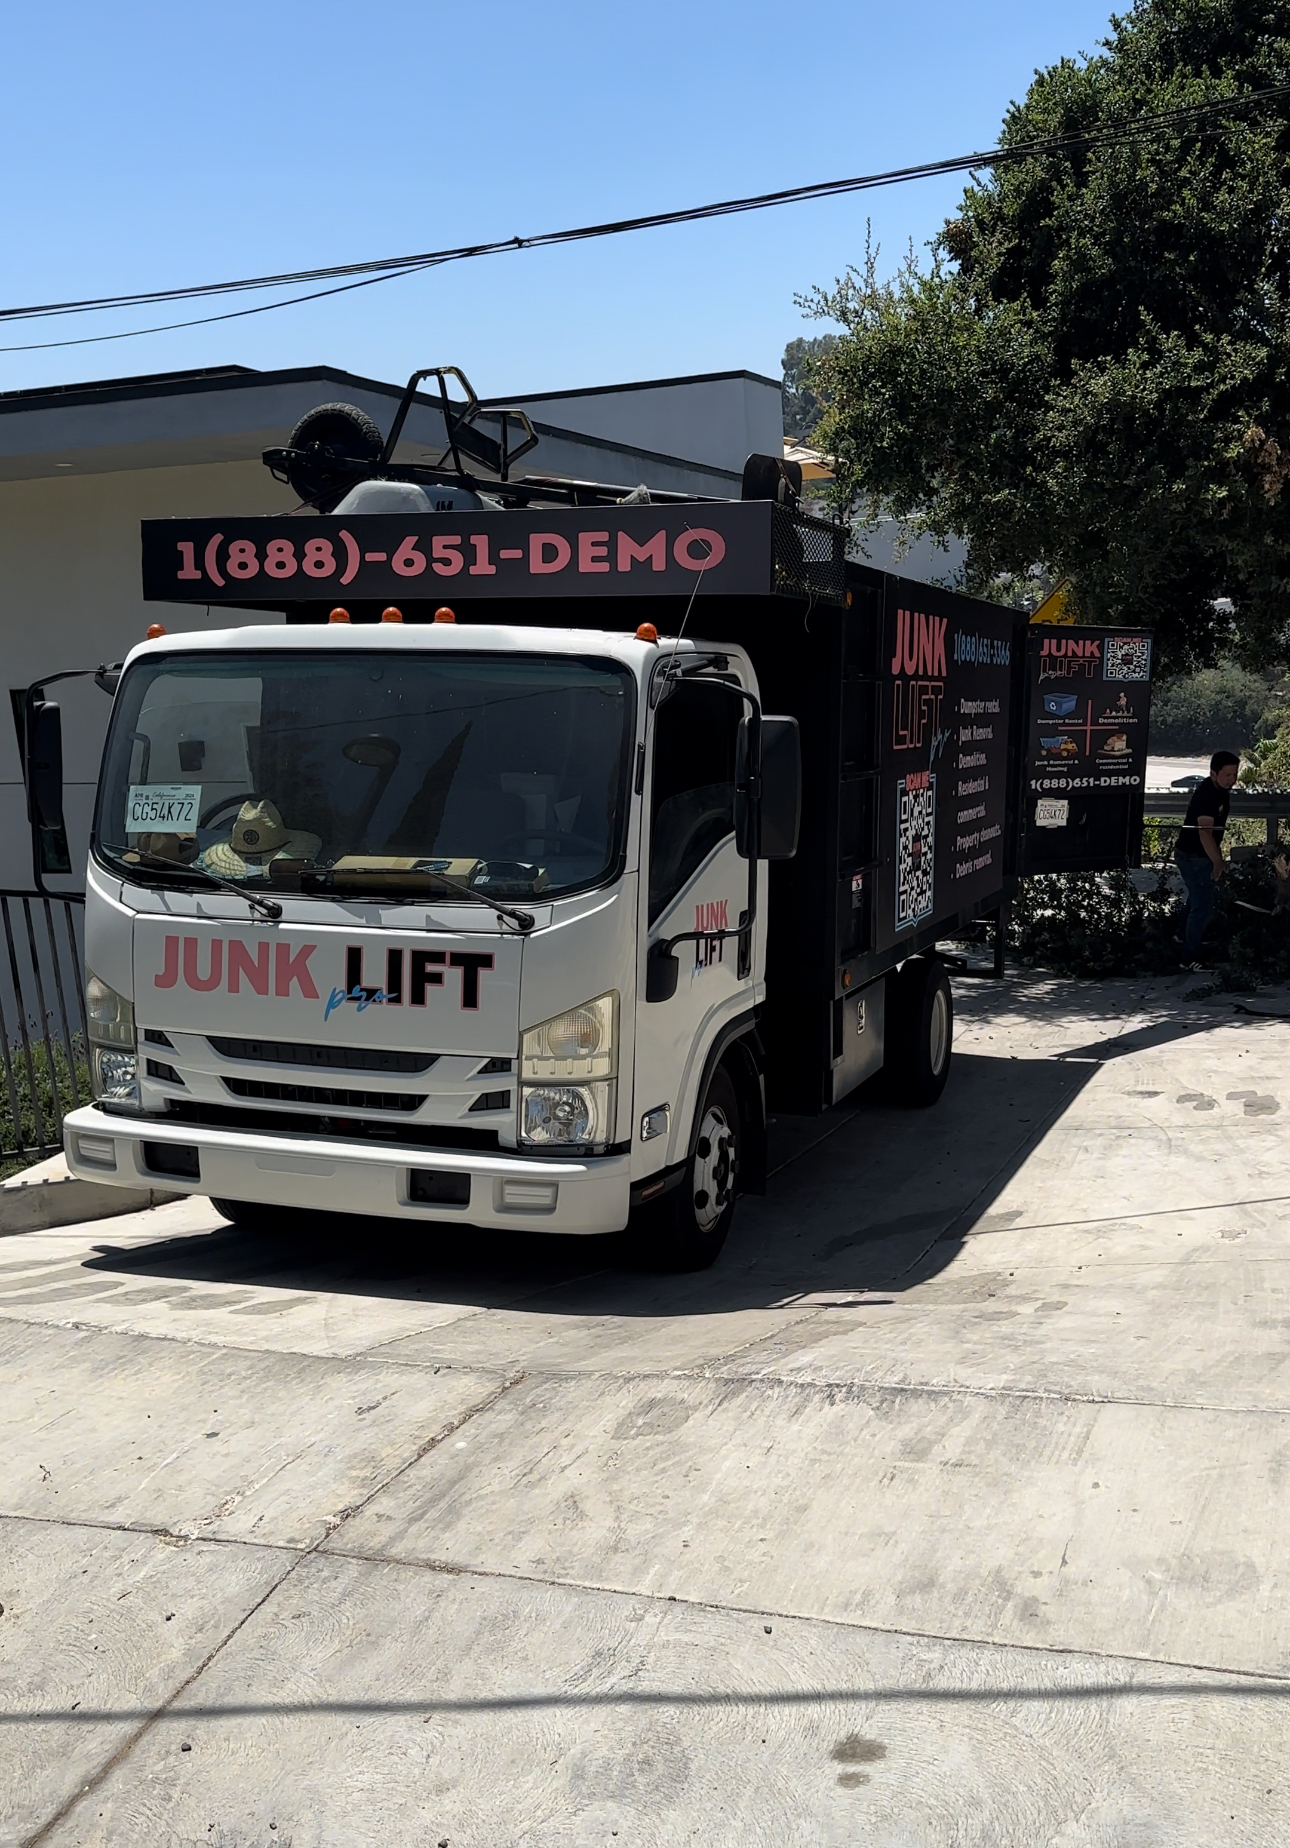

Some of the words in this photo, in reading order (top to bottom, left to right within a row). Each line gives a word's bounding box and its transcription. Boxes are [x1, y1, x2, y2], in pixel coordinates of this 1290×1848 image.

[176, 528, 726, 586] 1(888)-651-DEMO
[891, 608, 948, 677] JUNK
[953, 629, 1010, 667] 1(888)651-3366
[1039, 638, 1101, 657] JUNK
[1040, 657, 1099, 678] LIFT
[893, 680, 944, 750] LIFT
[960, 697, 985, 718] Dumpster
[958, 725, 972, 746] Junk
[957, 776, 985, 797] Residential
[1029, 775, 1140, 792] 1(888)651-DEMO
[132, 802, 194, 821] CG54K72
[956, 831, 980, 853] Property
[955, 858, 973, 879] Debris
[693, 899, 729, 932] JUNK
[154, 935, 320, 999] JUNK
[344, 945, 496, 1011] LIFT
